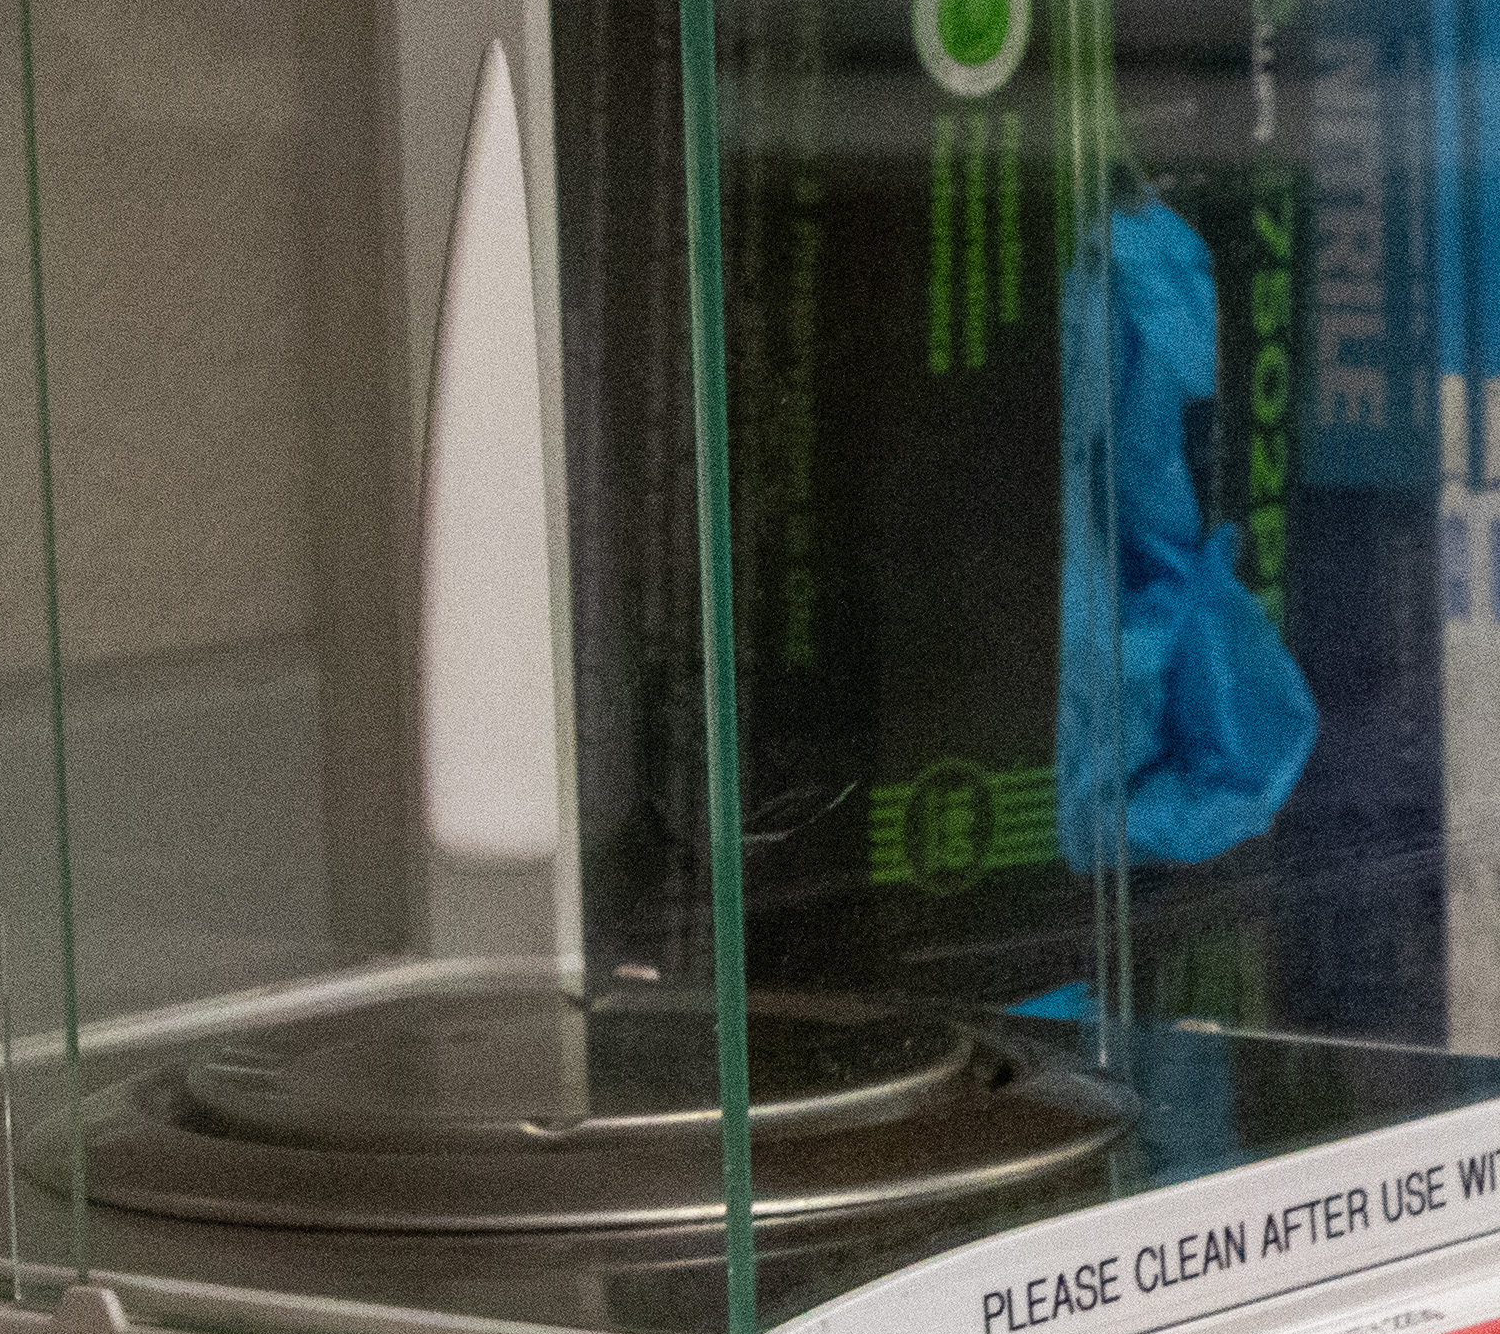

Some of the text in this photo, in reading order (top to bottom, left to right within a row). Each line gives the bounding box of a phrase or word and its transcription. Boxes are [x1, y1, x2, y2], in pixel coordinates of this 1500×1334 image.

[1134, 1222, 1247, 1293] CLEAN
[1261, 1191, 1369, 1258] AFTER
[1381, 1165, 1446, 1222] USE
